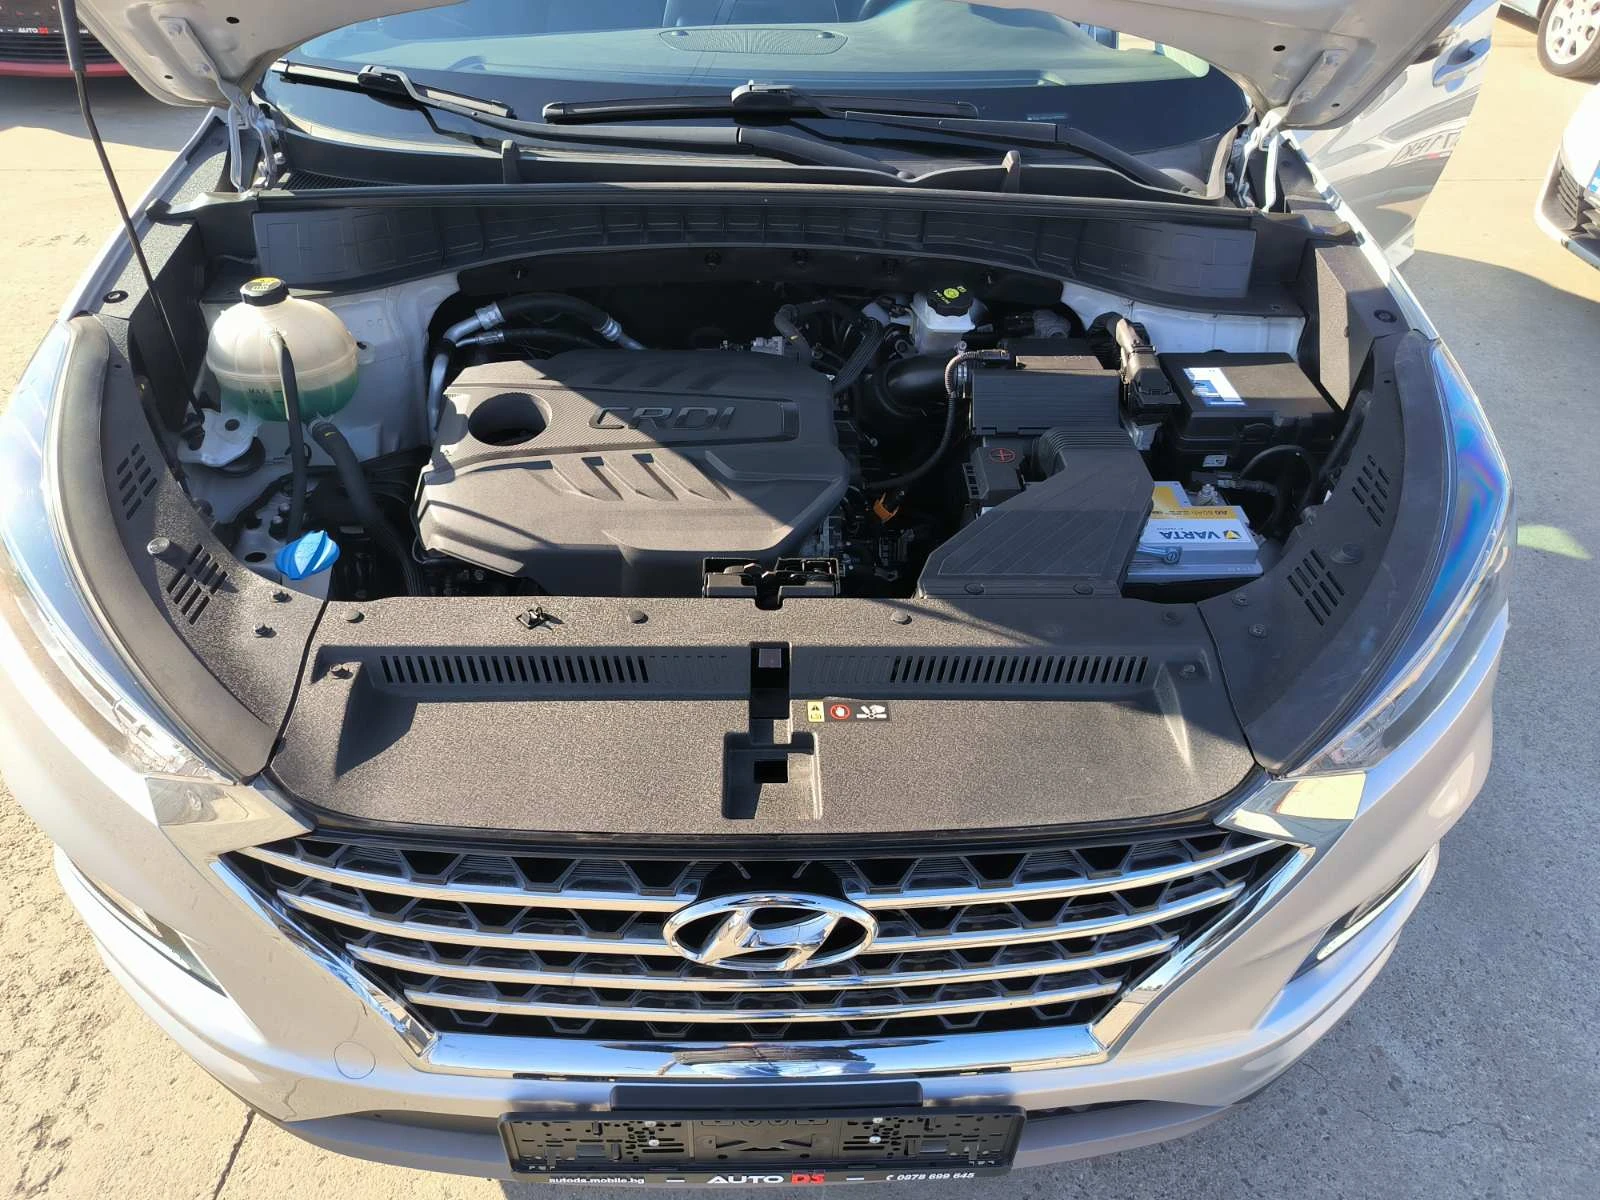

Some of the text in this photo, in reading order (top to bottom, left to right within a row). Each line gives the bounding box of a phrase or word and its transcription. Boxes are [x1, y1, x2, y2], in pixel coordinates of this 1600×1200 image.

[588, 406, 737, 430] CRDI
[1159, 529, 1222, 540] VARTA
[706, 1174, 784, 1185] AUTO
